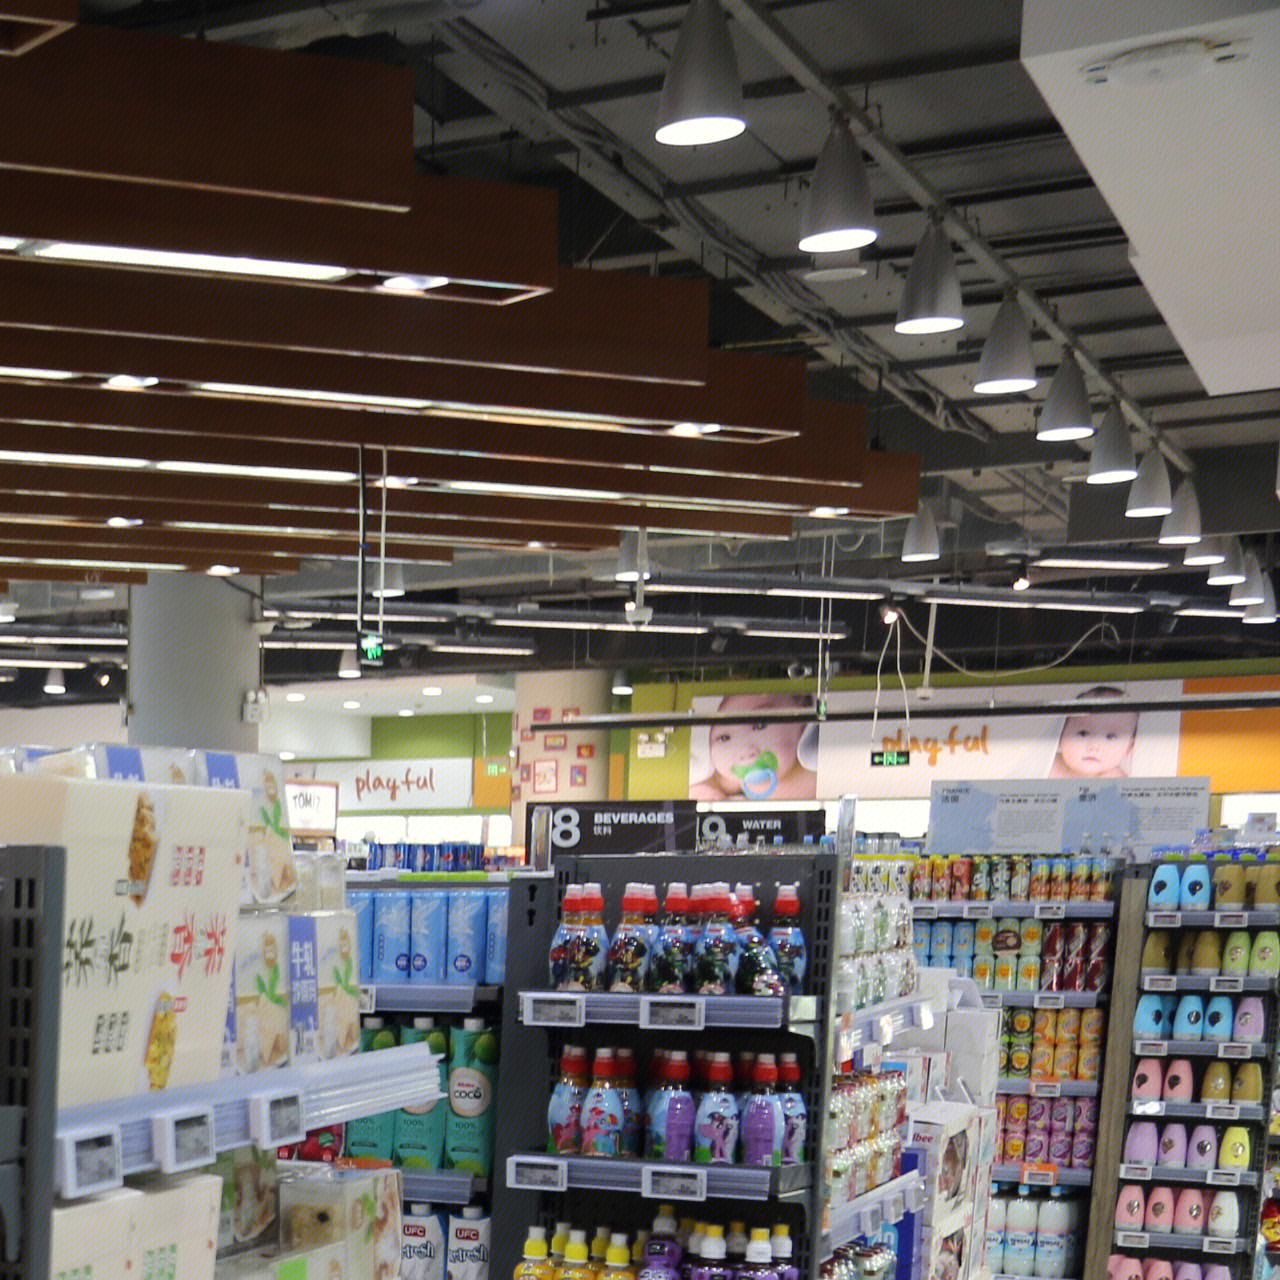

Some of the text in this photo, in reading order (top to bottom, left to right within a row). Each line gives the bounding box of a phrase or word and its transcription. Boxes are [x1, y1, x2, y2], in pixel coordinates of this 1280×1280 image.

[882, 725, 989, 766] playful
[355, 768, 436, 800] playful
[552, 808, 675, 848] 8 BEVERAGES
[742, 818, 782, 830] WATER
[593, 826, 612, 836] 饮料
[404, 1226, 426, 1237] UFC
[456, 1229, 479, 1240] UFC
